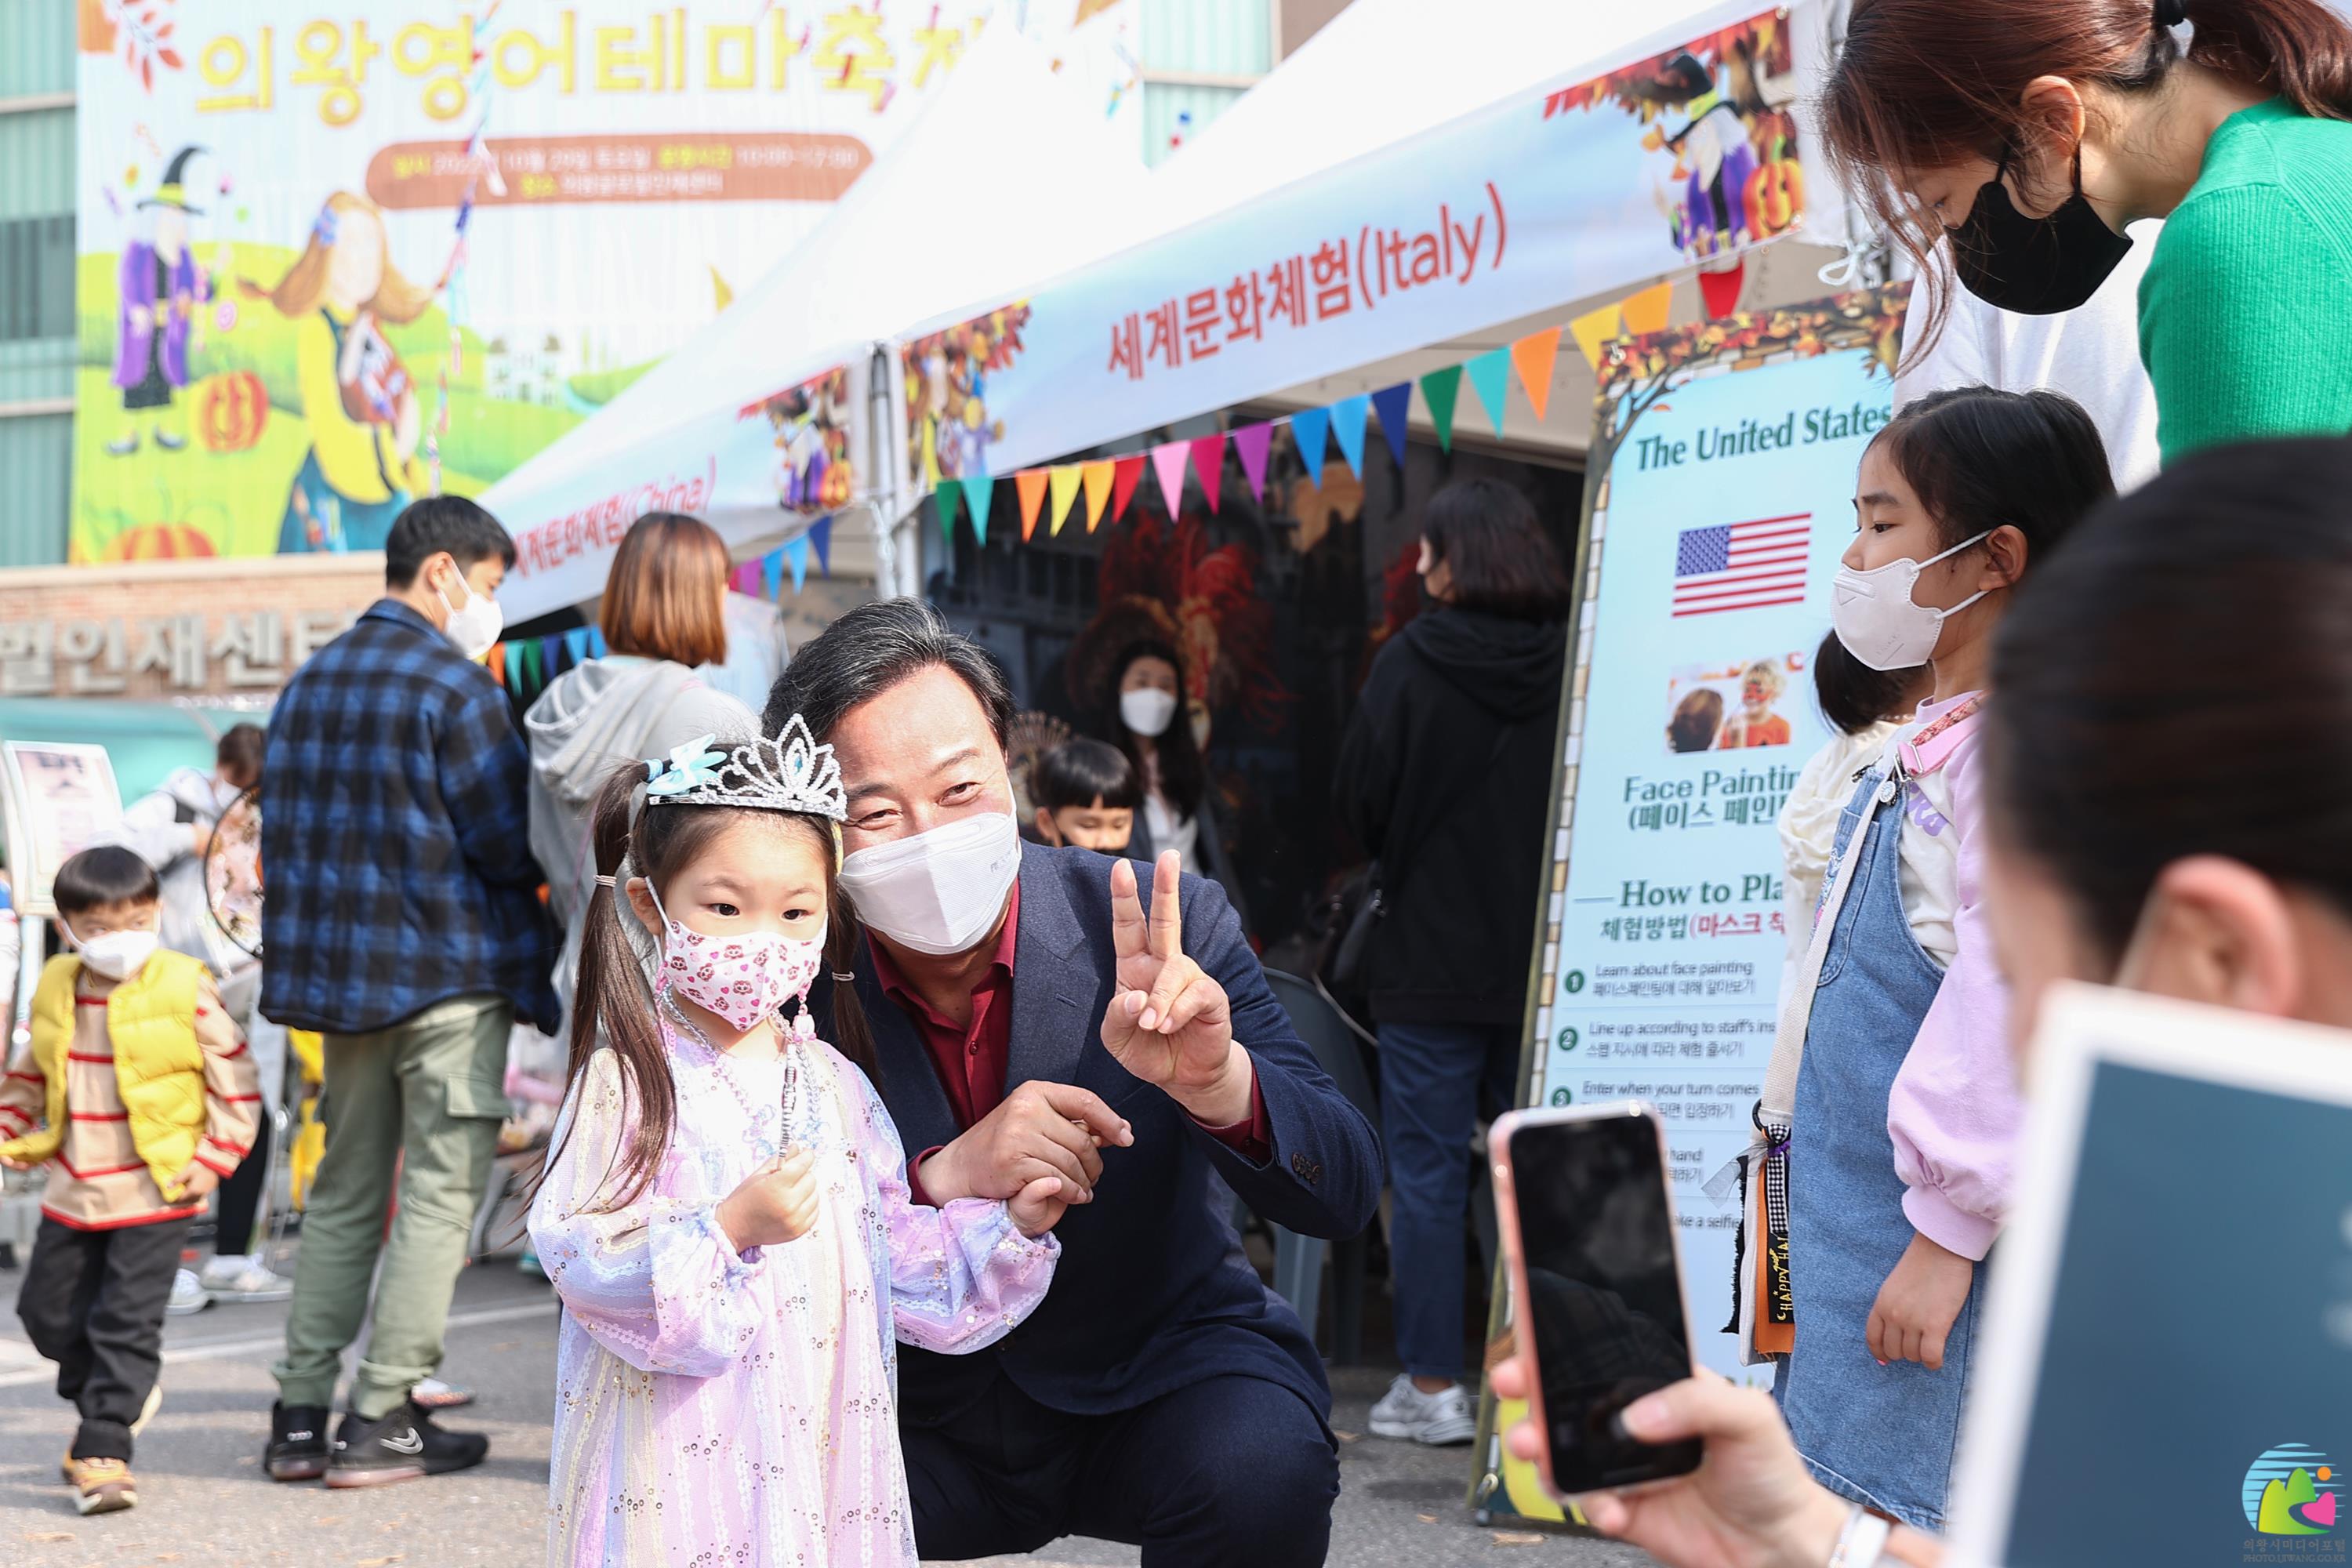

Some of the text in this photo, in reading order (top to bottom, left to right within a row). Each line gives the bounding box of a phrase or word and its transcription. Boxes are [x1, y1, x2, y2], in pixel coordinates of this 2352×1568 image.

[1108, 181, 1507, 380] 세계문화체험(Italy)
[1635, 402, 1892, 471] The United States
[1623, 775, 1693, 803] Face
[1628, 800, 1715, 830] (페이스
[1620, 879, 1692, 907] How
[1699, 880, 1731, 904] to
[1595, 963, 1630, 977] Learn
[1632, 962, 1668, 977] about
[1670, 960, 1697, 975] face
[1699, 960, 1755, 978] painting
[1588, 1021, 1614, 1036] Line
[1617, 1023, 1635, 1036] up
[1636, 1021, 1699, 1036] according
[1701, 1022, 1715, 1033] to
[1581, 1080, 1613, 1096] Enter
[1617, 1080, 1653, 1095] when
[1653, 1083, 1685, 1097] your
[1686, 1082, 1714, 1095] turn
[1715, 1082, 1759, 1095] comes
[1670, 1147, 1702, 1163] hand
[1696, 1217, 1706, 1228] a
